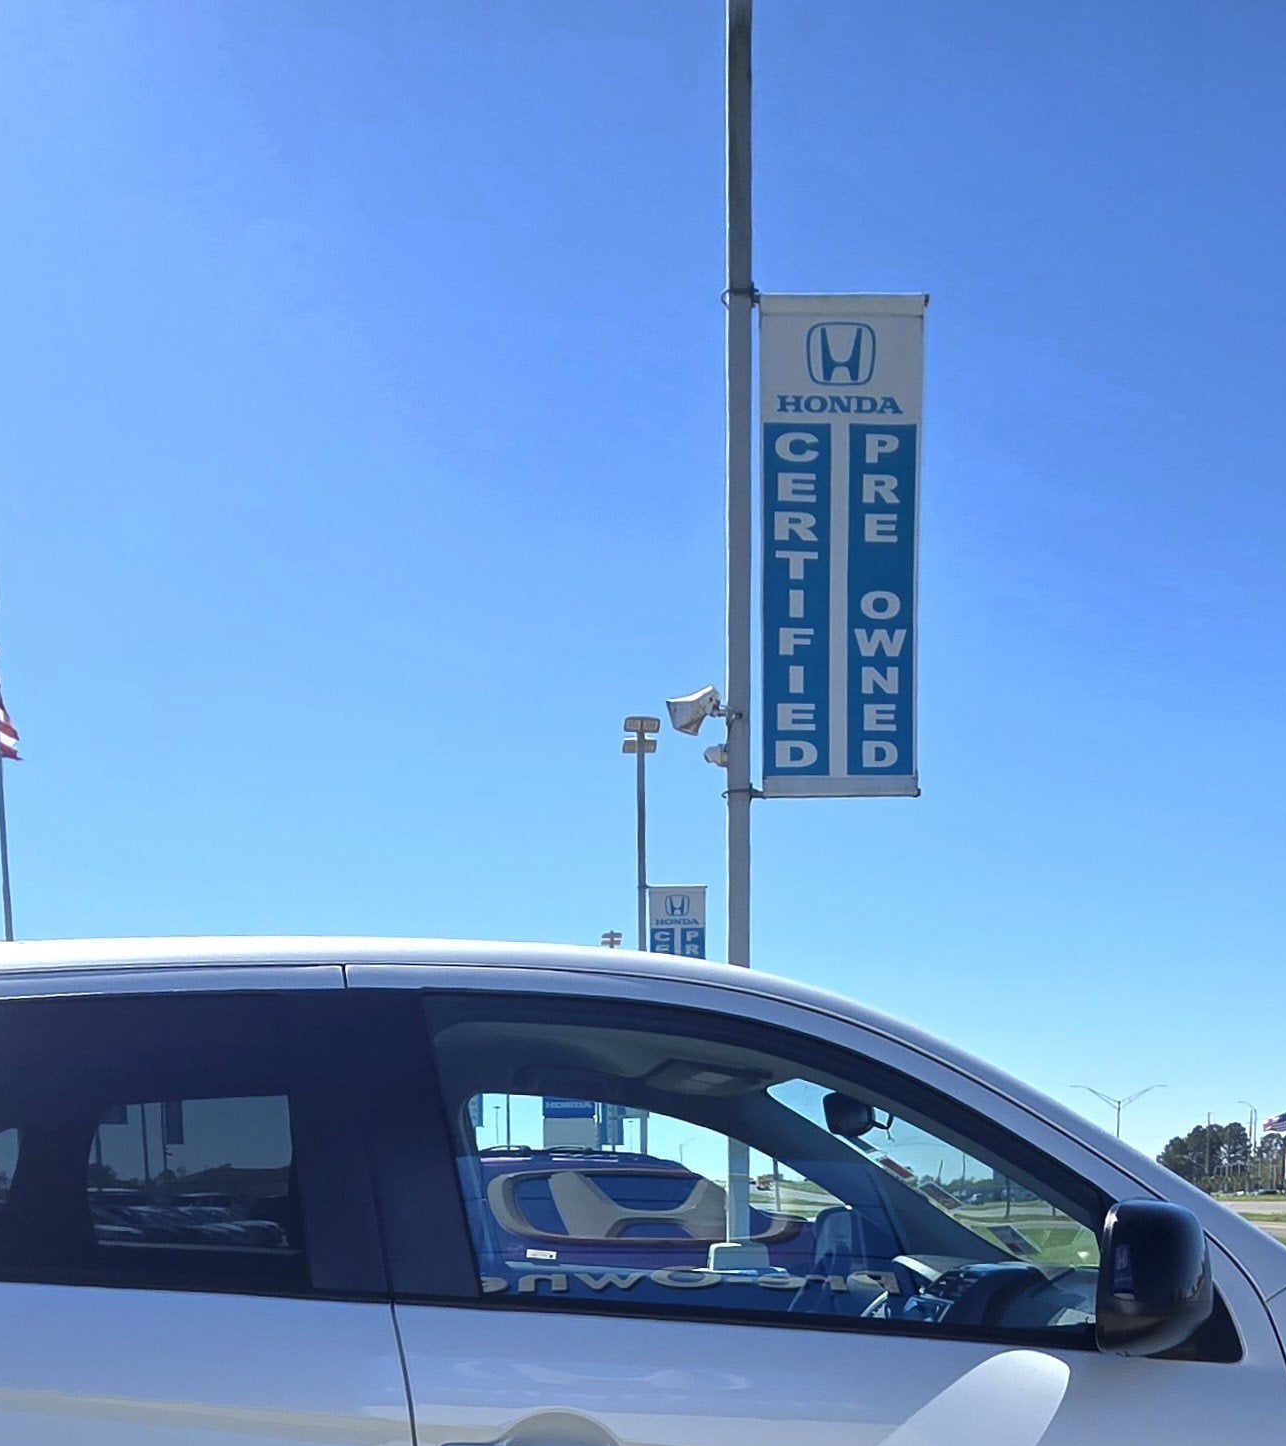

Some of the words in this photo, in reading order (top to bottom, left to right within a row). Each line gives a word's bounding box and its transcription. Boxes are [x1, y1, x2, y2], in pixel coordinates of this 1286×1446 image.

[775, 393, 904, 415] HONDA
[861, 432, 901, 544] PRE
[773, 430, 820, 769] CERTIFIED
[853, 590, 907, 769] OWNED
[654, 917, 700, 927] HONDA
